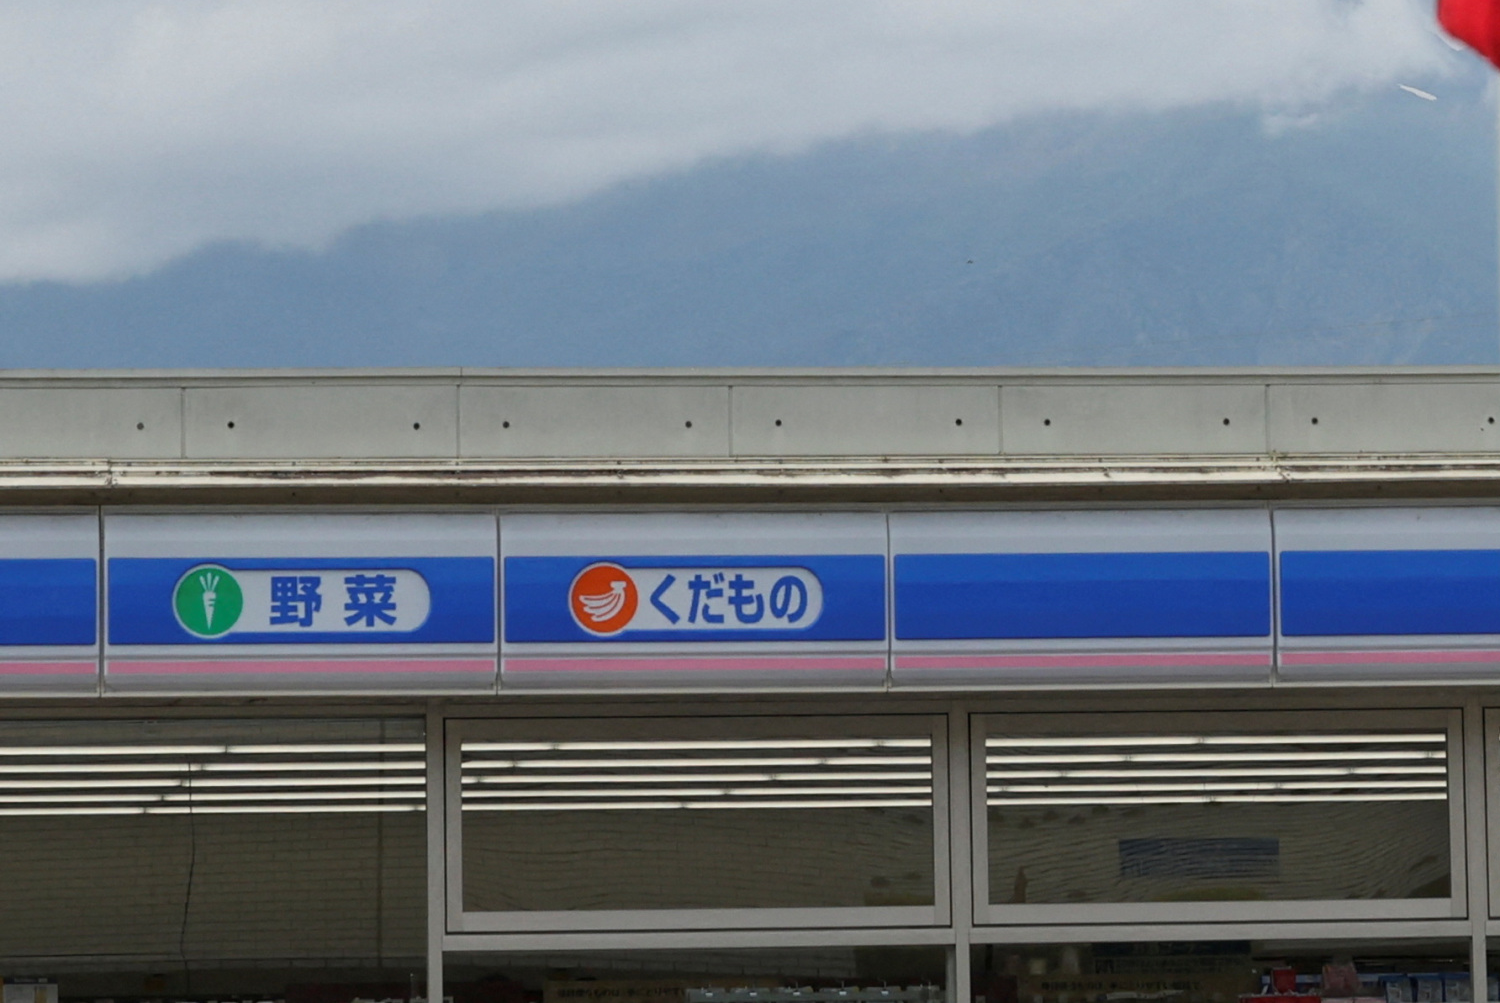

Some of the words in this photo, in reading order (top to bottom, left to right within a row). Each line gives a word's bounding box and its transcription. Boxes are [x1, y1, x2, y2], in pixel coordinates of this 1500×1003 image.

[270, 574, 397, 627] 野菜
[650, 572, 808, 625] くだもの
